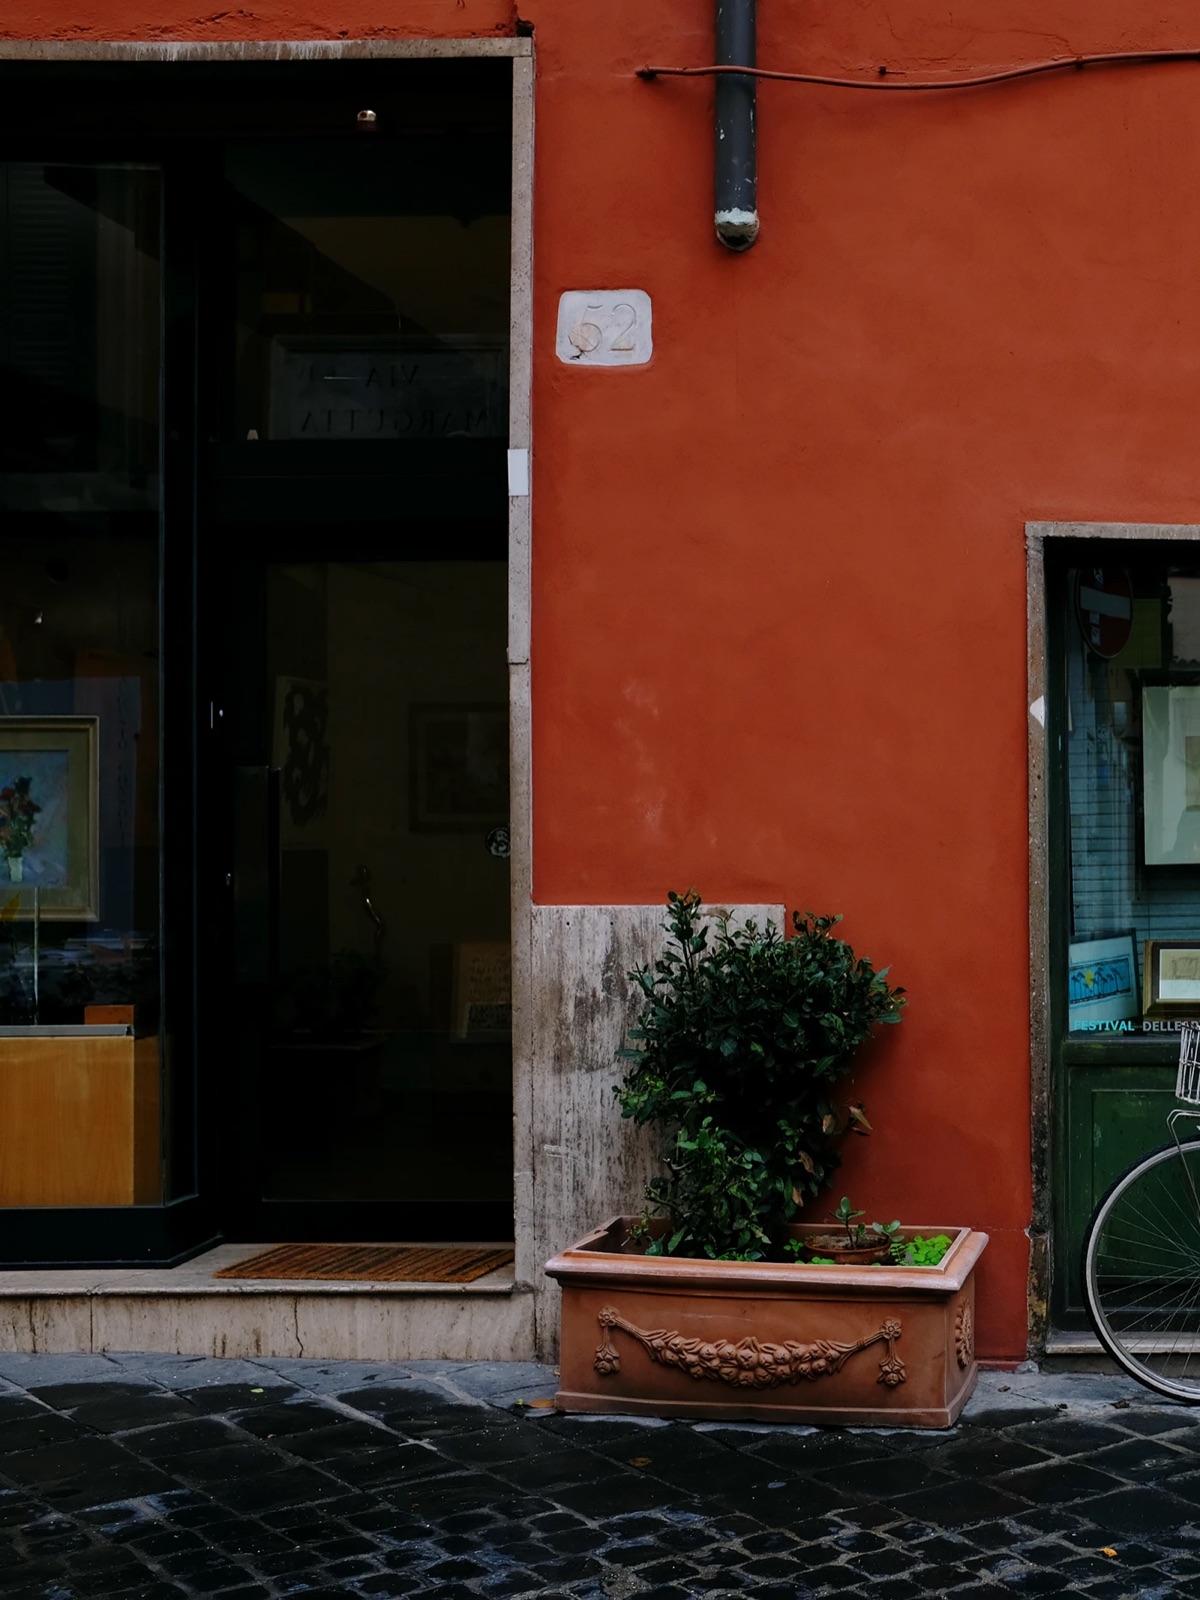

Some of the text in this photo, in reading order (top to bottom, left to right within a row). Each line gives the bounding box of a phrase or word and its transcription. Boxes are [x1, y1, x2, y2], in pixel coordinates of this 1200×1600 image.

[567, 303, 637, 353] 52
[1073, 1020, 1136, 1032] FESTIVAL
[1142, 1020, 1182, 1032] DELLE
